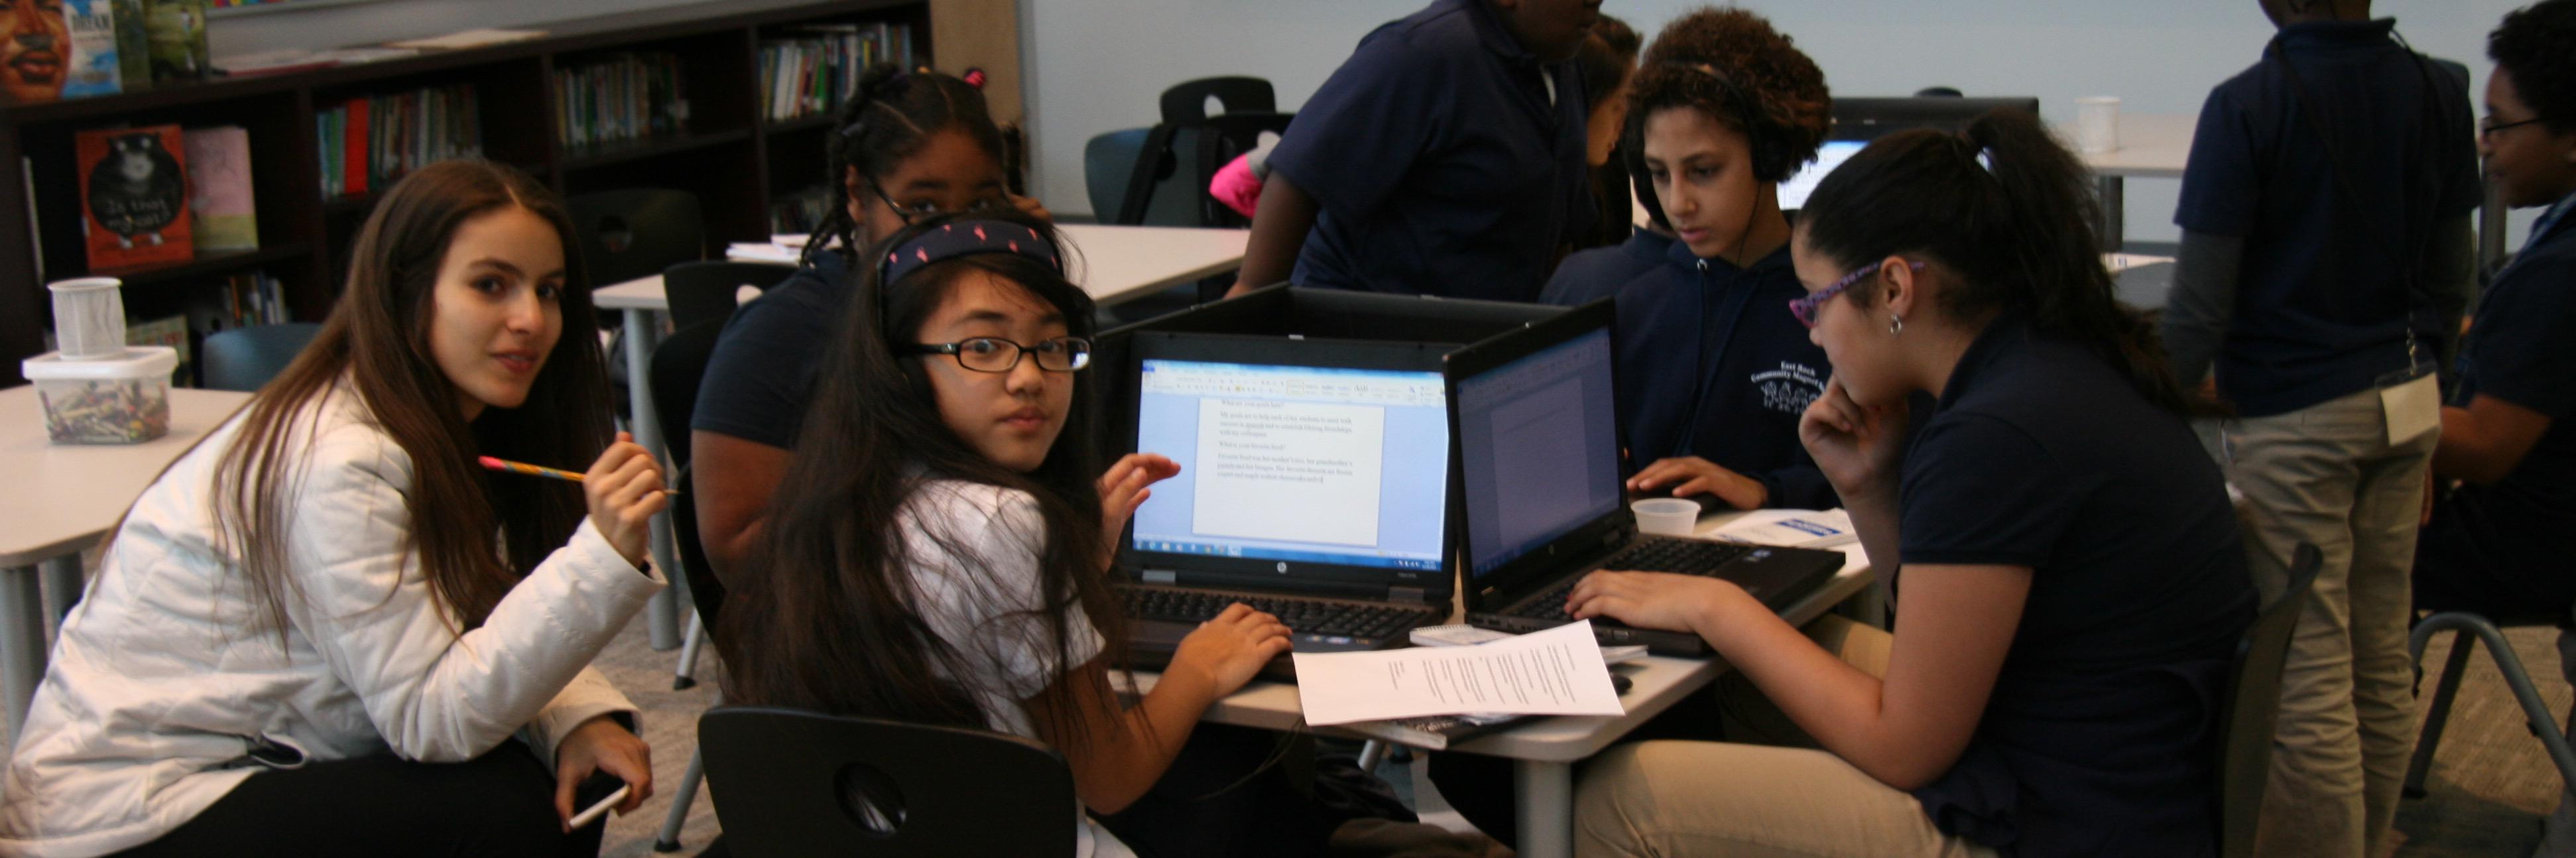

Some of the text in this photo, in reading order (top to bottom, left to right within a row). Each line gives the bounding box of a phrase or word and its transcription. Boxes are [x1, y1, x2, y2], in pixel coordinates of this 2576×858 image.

[1781, 361, 1815, 379] East Rock
[1751, 371, 1791, 383] Community
[1793, 371, 1819, 387] Magnet
